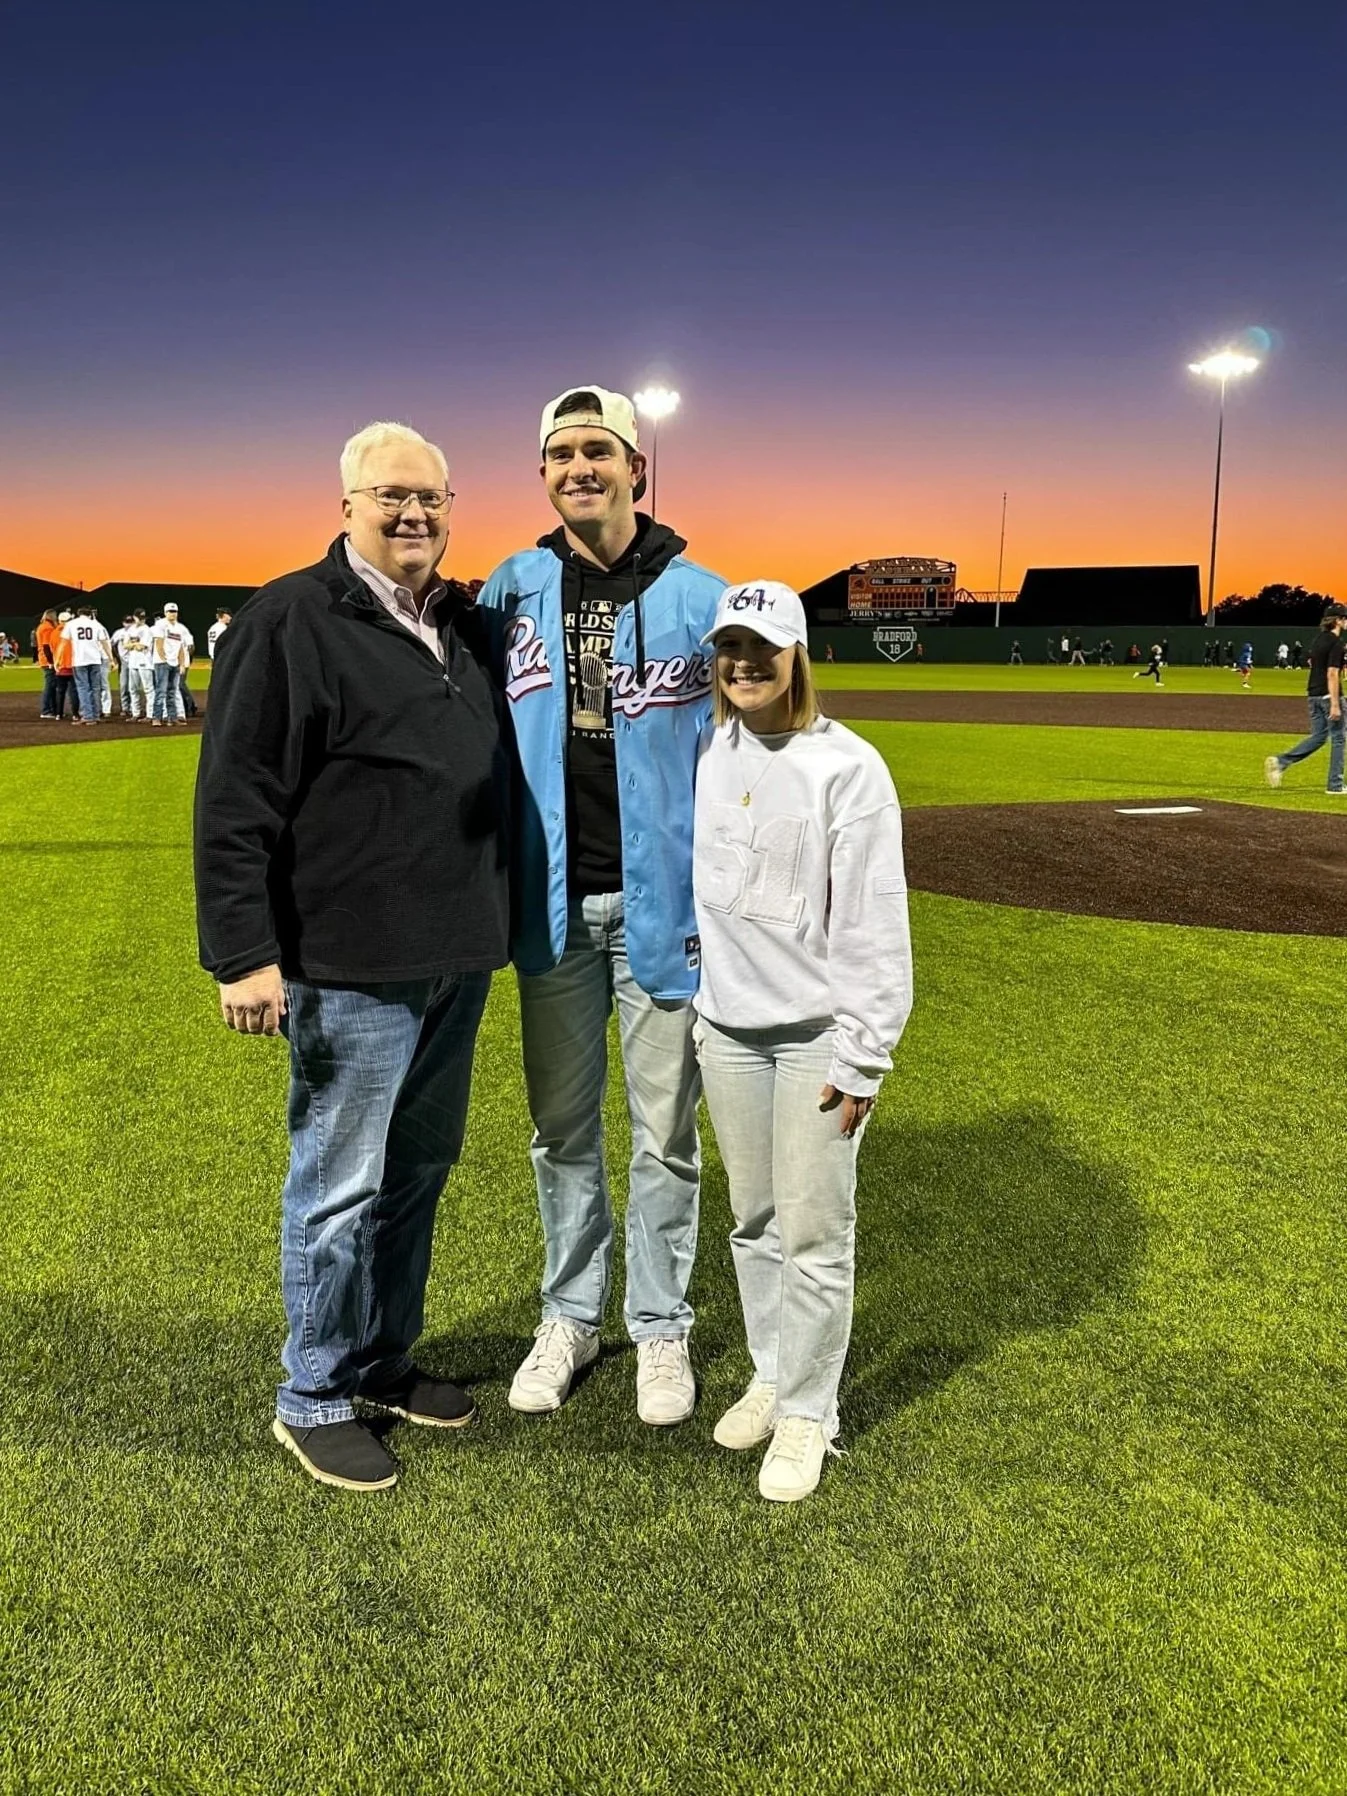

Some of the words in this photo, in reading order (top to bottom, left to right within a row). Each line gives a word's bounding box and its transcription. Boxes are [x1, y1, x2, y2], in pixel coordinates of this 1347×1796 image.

[77, 627, 93, 640] 20
[873, 631, 917, 641] BRADFORD
[889, 643, 901, 654] 18
